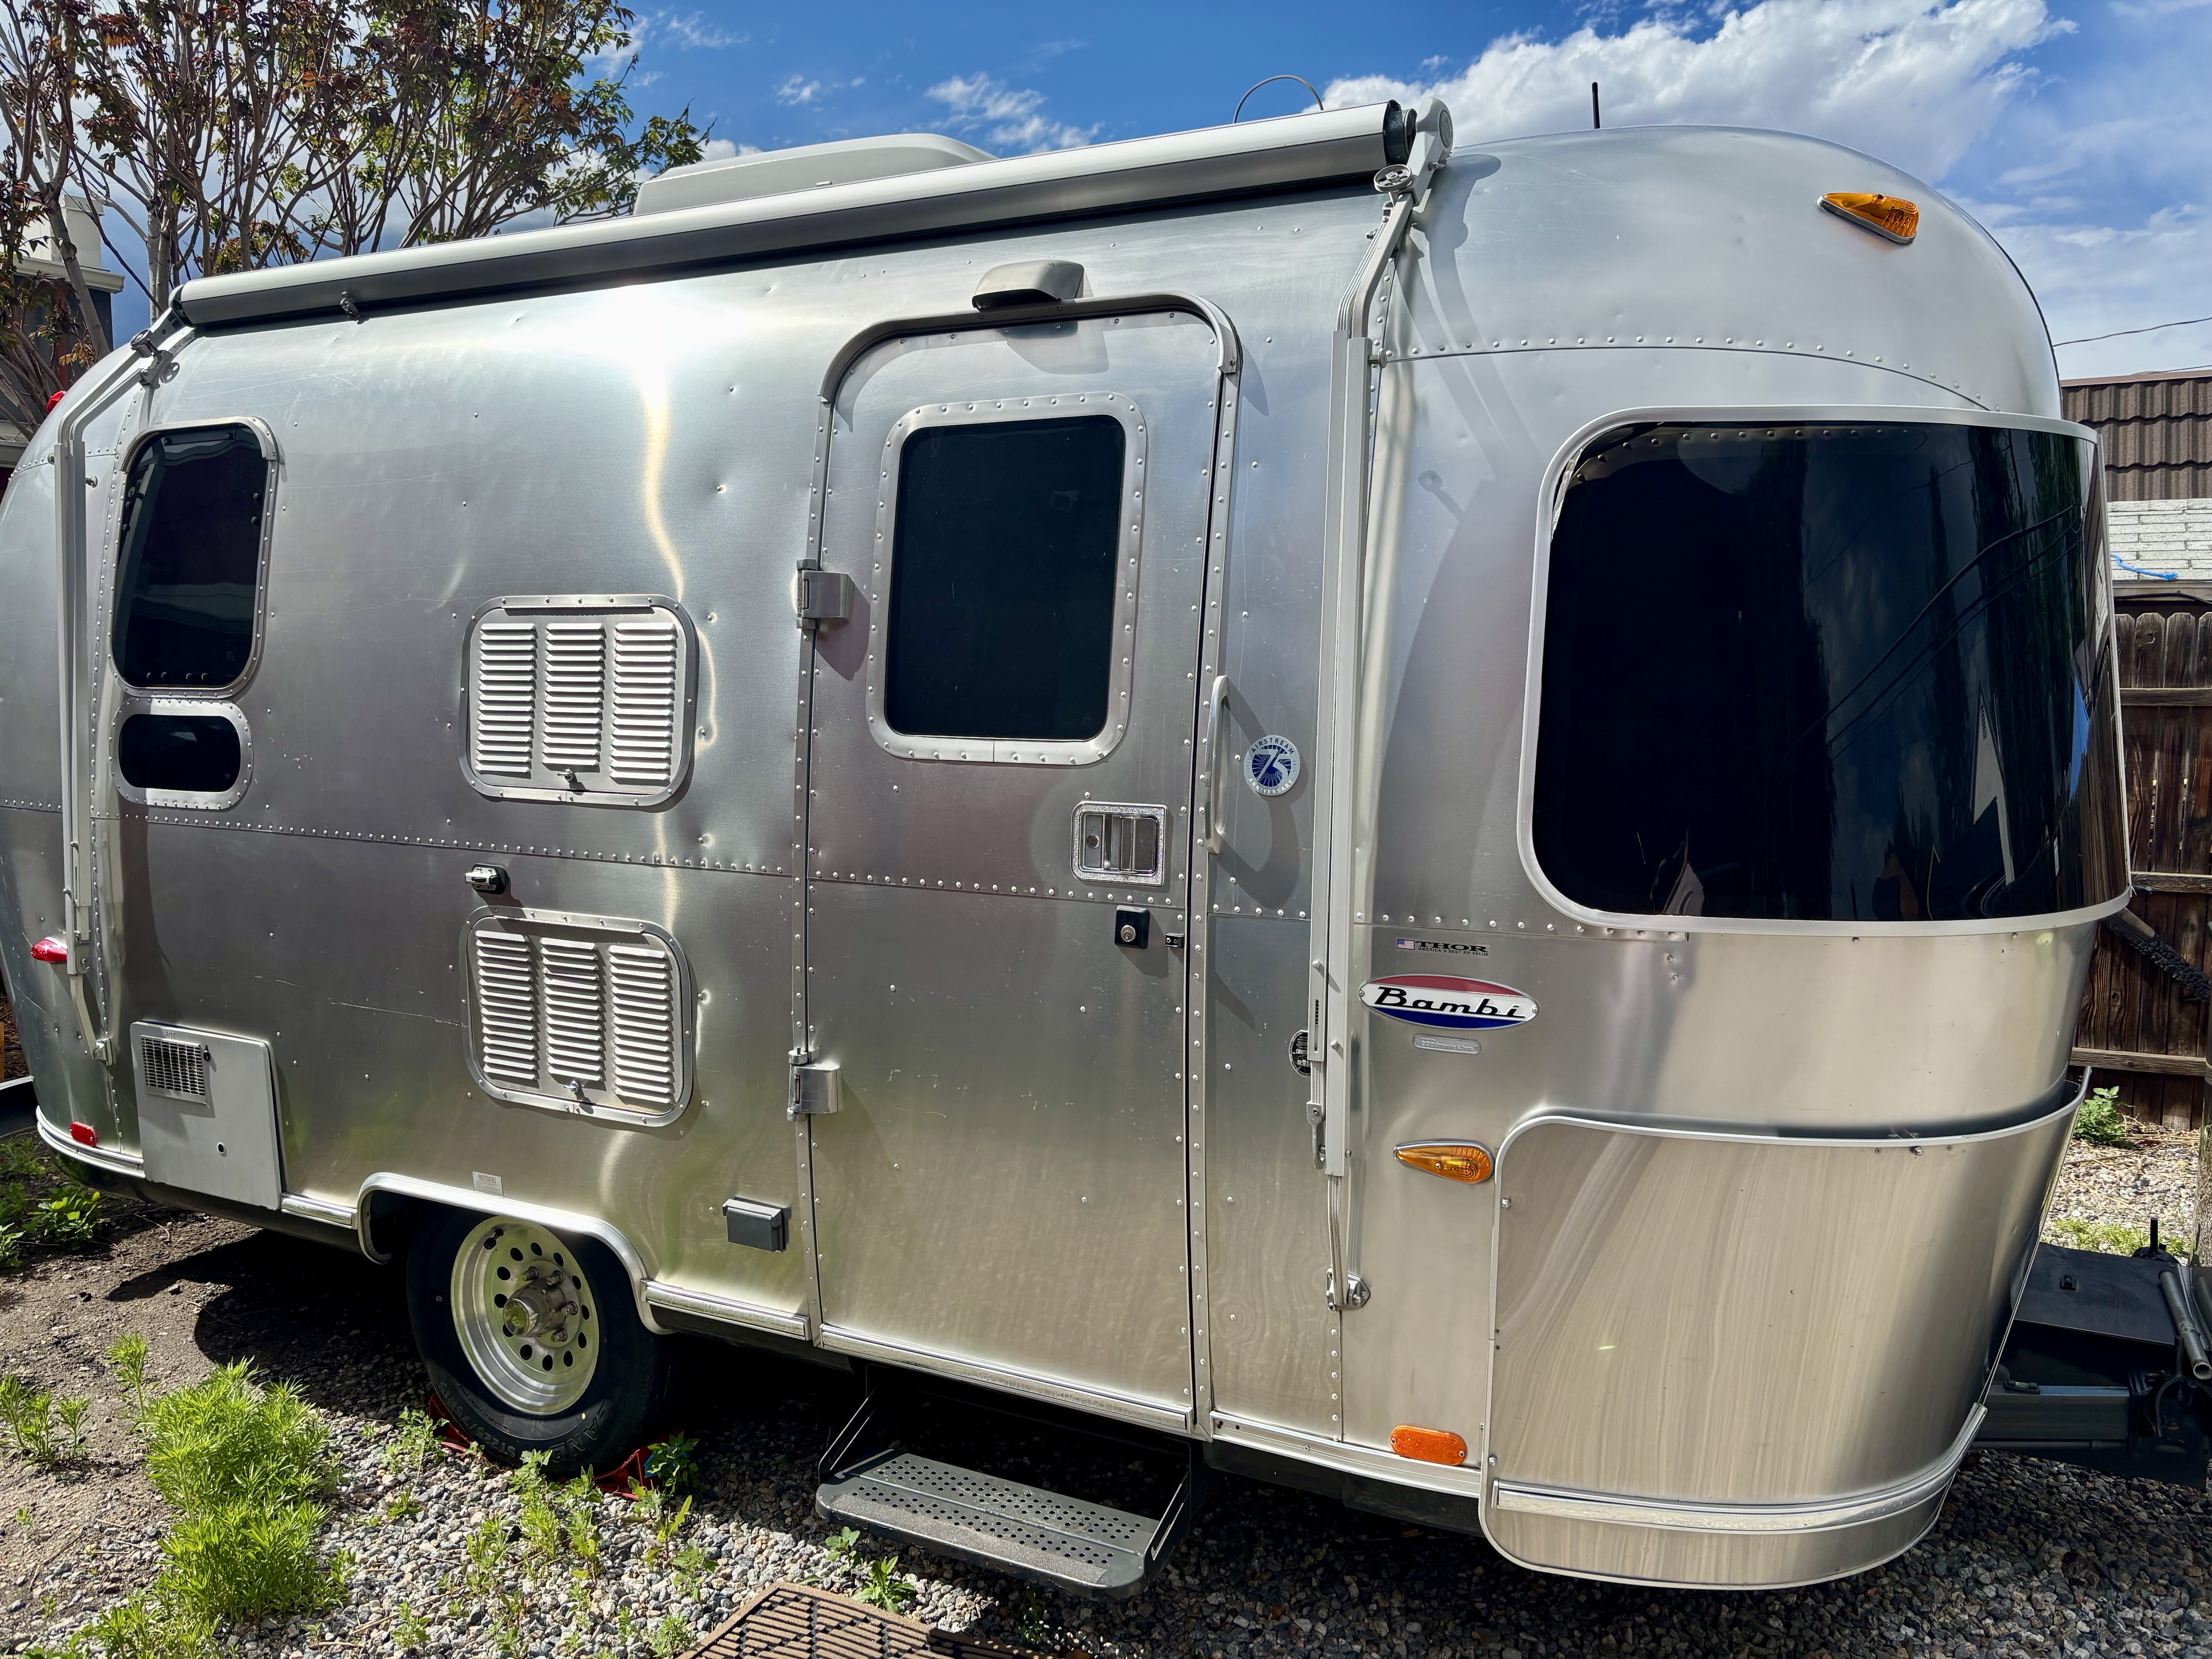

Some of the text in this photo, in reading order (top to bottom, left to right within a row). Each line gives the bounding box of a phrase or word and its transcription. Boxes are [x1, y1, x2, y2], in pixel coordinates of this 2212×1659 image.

[1251, 738, 1294, 754] AIRSTREAM
[1253, 748, 1290, 782] 75
[1248, 778, 1293, 794] ANNIVERSARY
[1415, 941, 1488, 952] THOR
[1374, 987, 1525, 1018] Bambi
[163, 1031, 175, 1039] HOT
